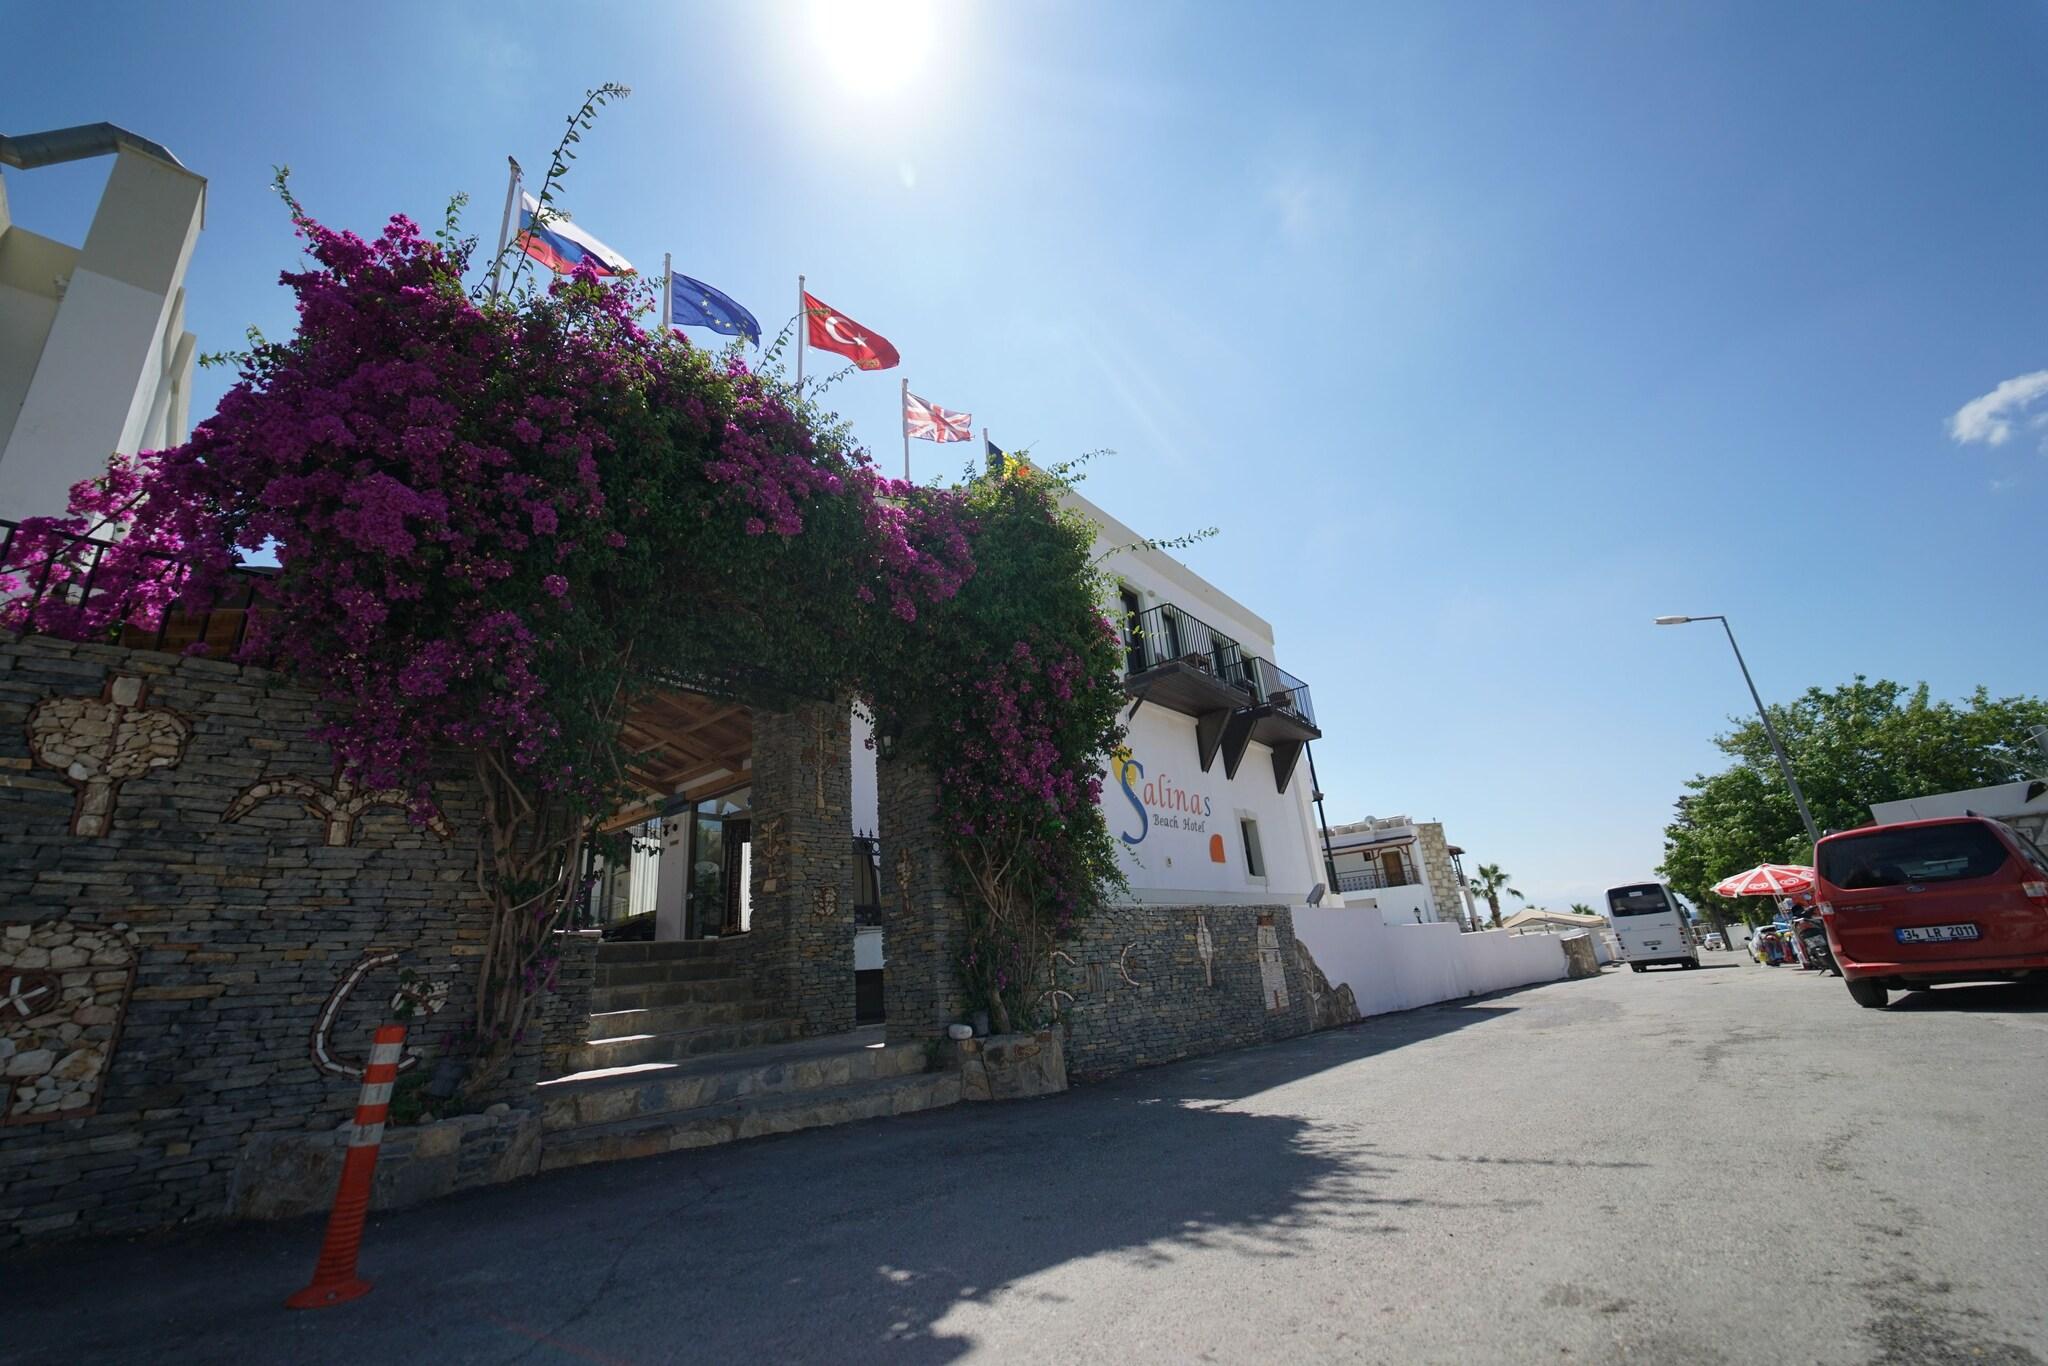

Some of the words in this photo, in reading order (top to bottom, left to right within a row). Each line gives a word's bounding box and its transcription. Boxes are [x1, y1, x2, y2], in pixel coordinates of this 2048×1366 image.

[1121, 759, 1211, 845] Salinas
[1153, 814, 1179, 829] Beach
[1182, 819, 1206, 833] Hotel
[1903, 929, 1919, 940] 34
[1925, 927, 1943, 938] LR
[1948, 925, 1976, 937] 2011
